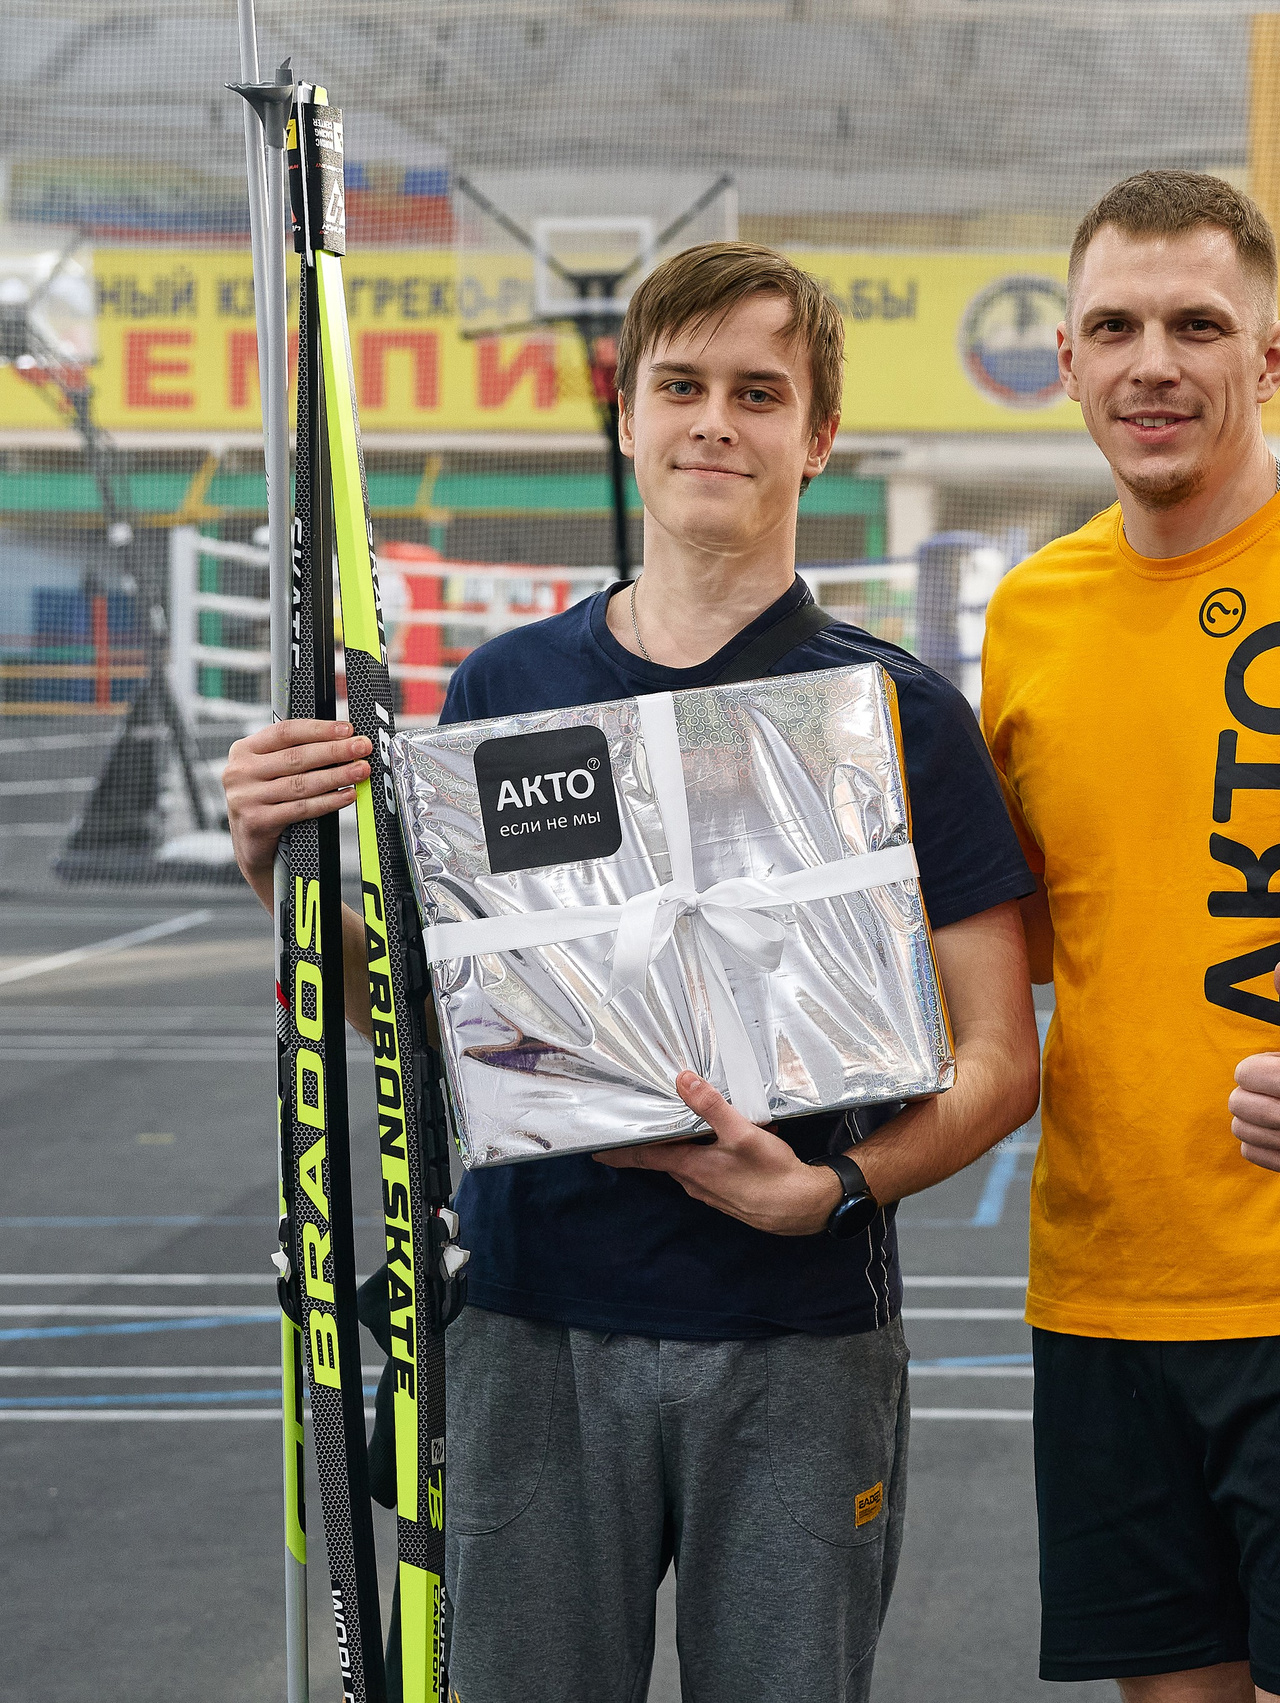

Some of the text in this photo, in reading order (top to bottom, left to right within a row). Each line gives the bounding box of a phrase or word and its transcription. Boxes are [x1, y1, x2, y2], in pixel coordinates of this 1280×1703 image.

[373, 701, 396, 816] 180
[496, 768, 596, 812] АКТО
[500, 811, 601, 837] если не мы
[294, 875, 342, 1390] BRADOS
[362, 878, 415, 1401] CARBON SKATE
